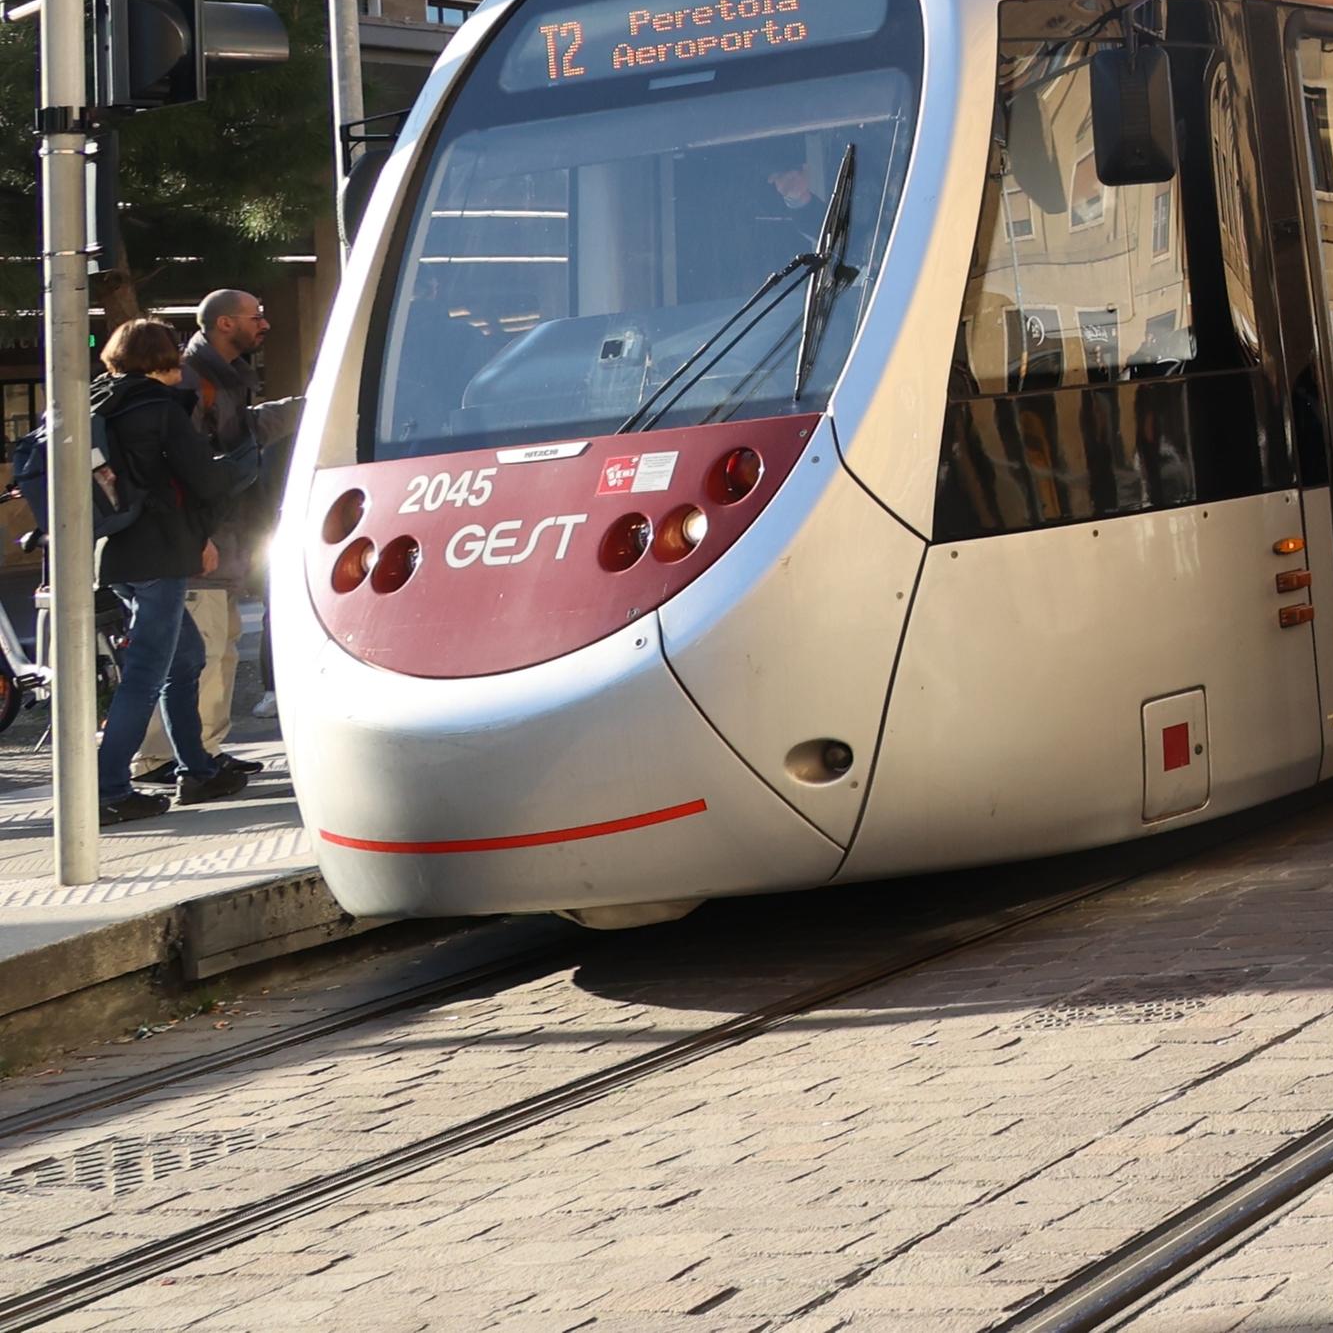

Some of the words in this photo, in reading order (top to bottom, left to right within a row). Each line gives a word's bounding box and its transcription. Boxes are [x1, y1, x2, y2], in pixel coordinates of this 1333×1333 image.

[538, 21, 585, 79] T2
[612, 19, 807, 69] Aeroporto
[398, 467, 497, 514] 2045
[445, 513, 588, 569] GEST
